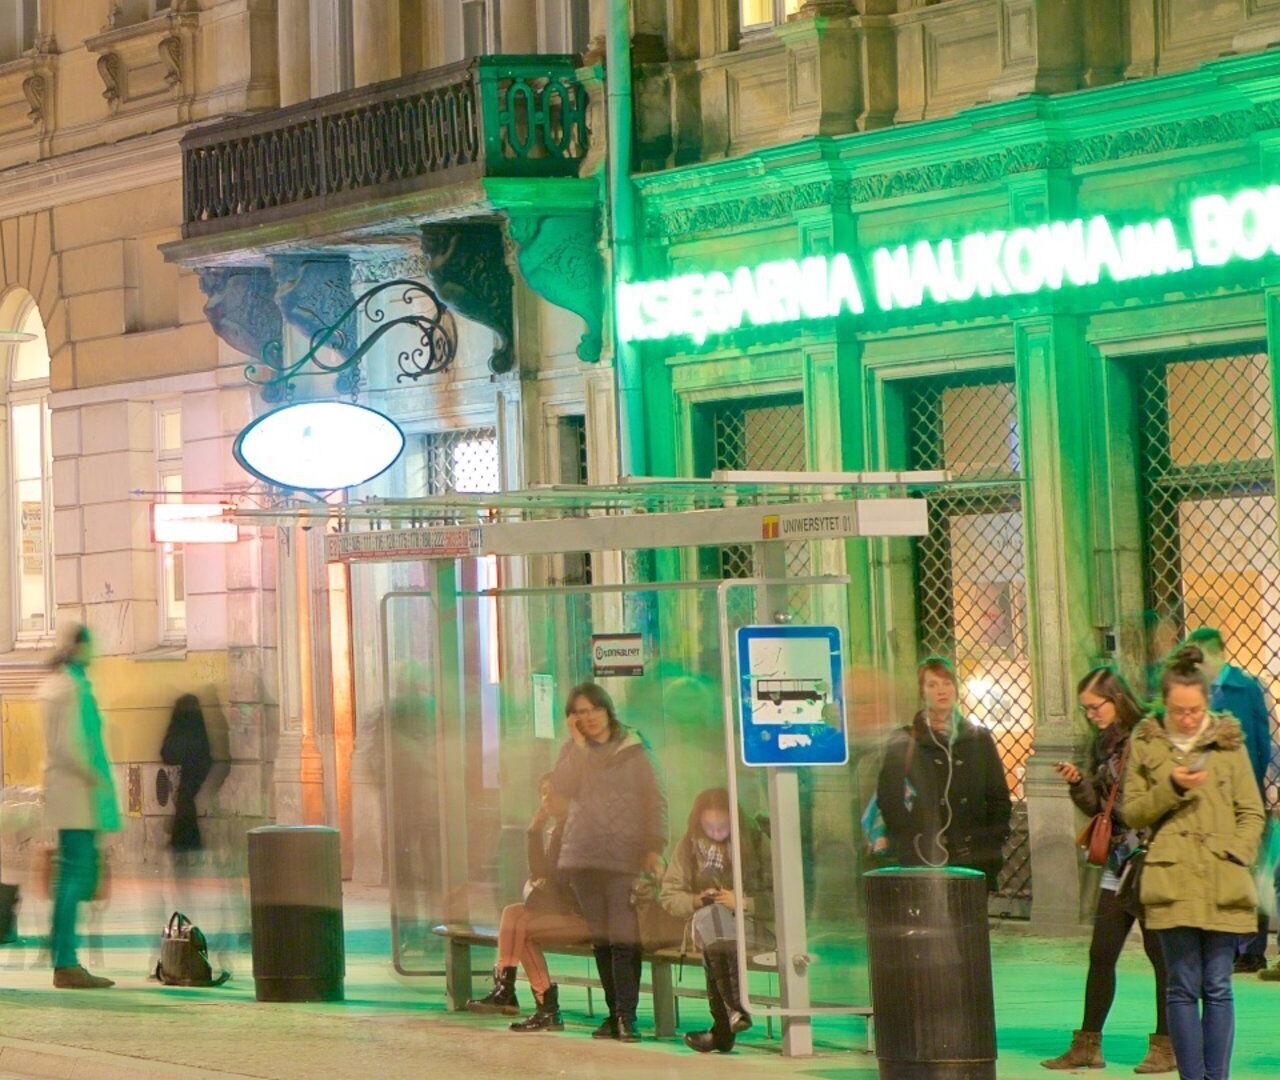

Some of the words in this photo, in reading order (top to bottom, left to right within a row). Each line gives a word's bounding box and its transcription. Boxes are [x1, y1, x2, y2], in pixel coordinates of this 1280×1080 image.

[873, 214, 1123, 311] NAUKOWA
[1190, 184, 1280, 267] BO
[783, 517, 840, 533] UNIWERSYTET
[842, 515, 852, 532] 01
